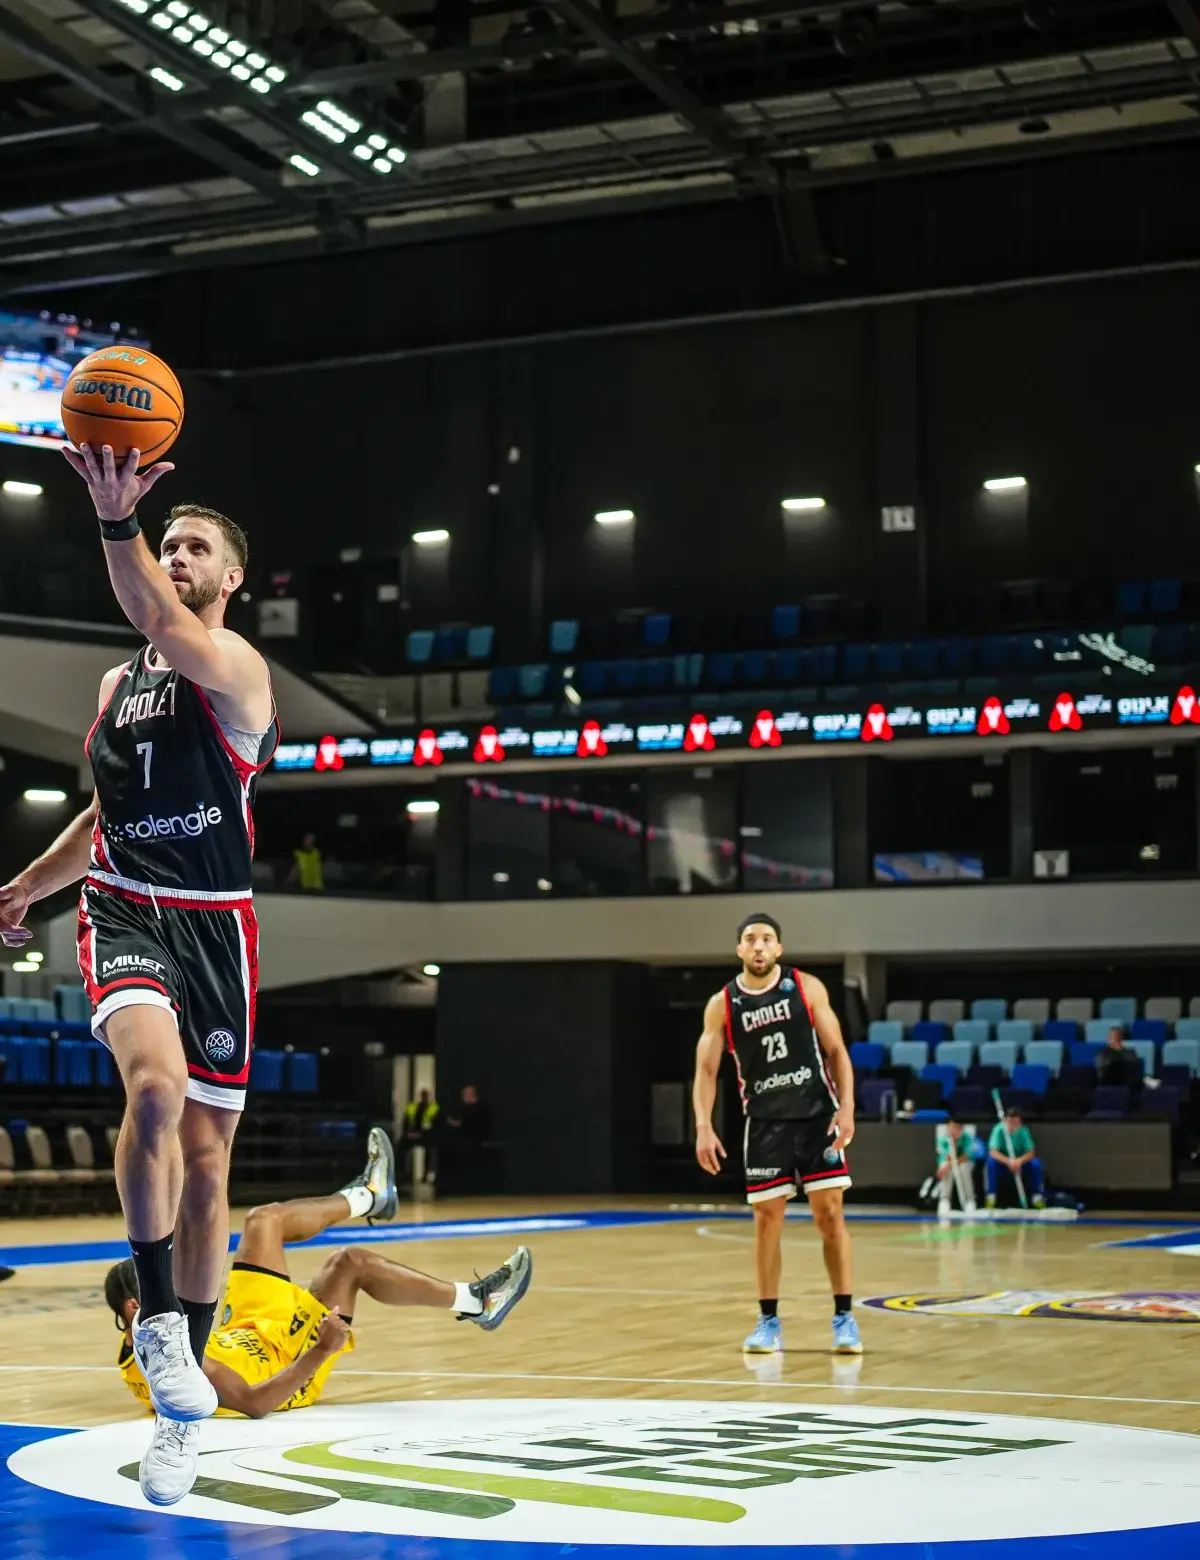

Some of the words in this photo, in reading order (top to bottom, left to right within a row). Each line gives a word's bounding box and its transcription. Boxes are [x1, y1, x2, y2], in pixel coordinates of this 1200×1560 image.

[74, 380, 152, 412] Wilson
[115, 683, 175, 728] CHOLET
[136, 742, 153, 789] 7
[125, 805, 222, 838] solengie
[102, 955, 165, 975] MILLET
[741, 999, 792, 1032] CHOLET
[761, 1031, 789, 1063] 23
